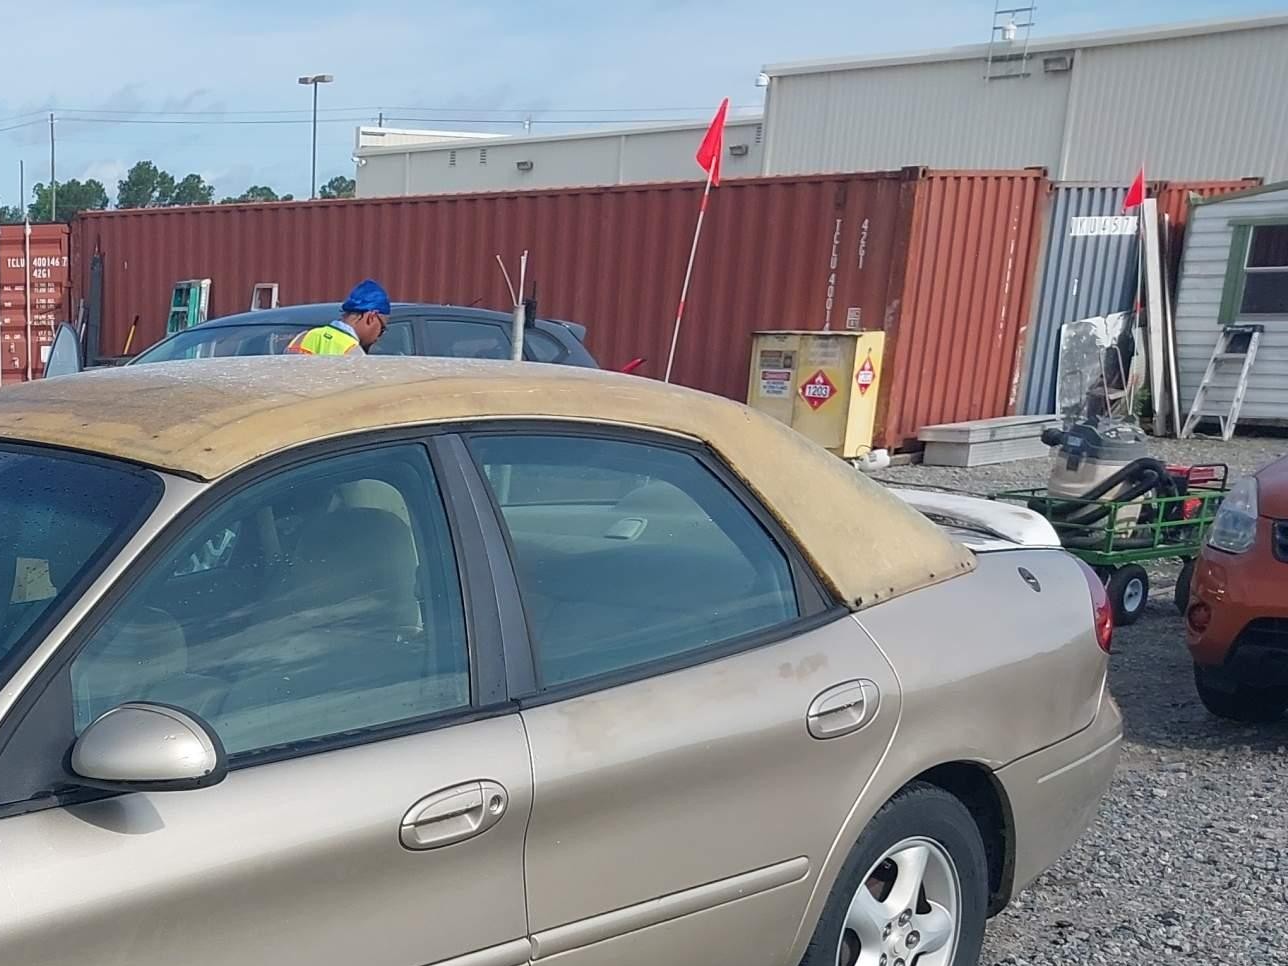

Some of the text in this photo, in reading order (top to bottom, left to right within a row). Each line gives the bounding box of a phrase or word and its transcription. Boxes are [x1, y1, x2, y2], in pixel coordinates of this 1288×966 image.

[830, 219, 842, 269] TCLU
[858, 218, 869, 269] 42G1
[7, 258, 25, 268] TCLU
[32, 256, 60, 267] 400146
[32, 268, 51, 278] 42G1
[808, 385, 828, 397] 1203
